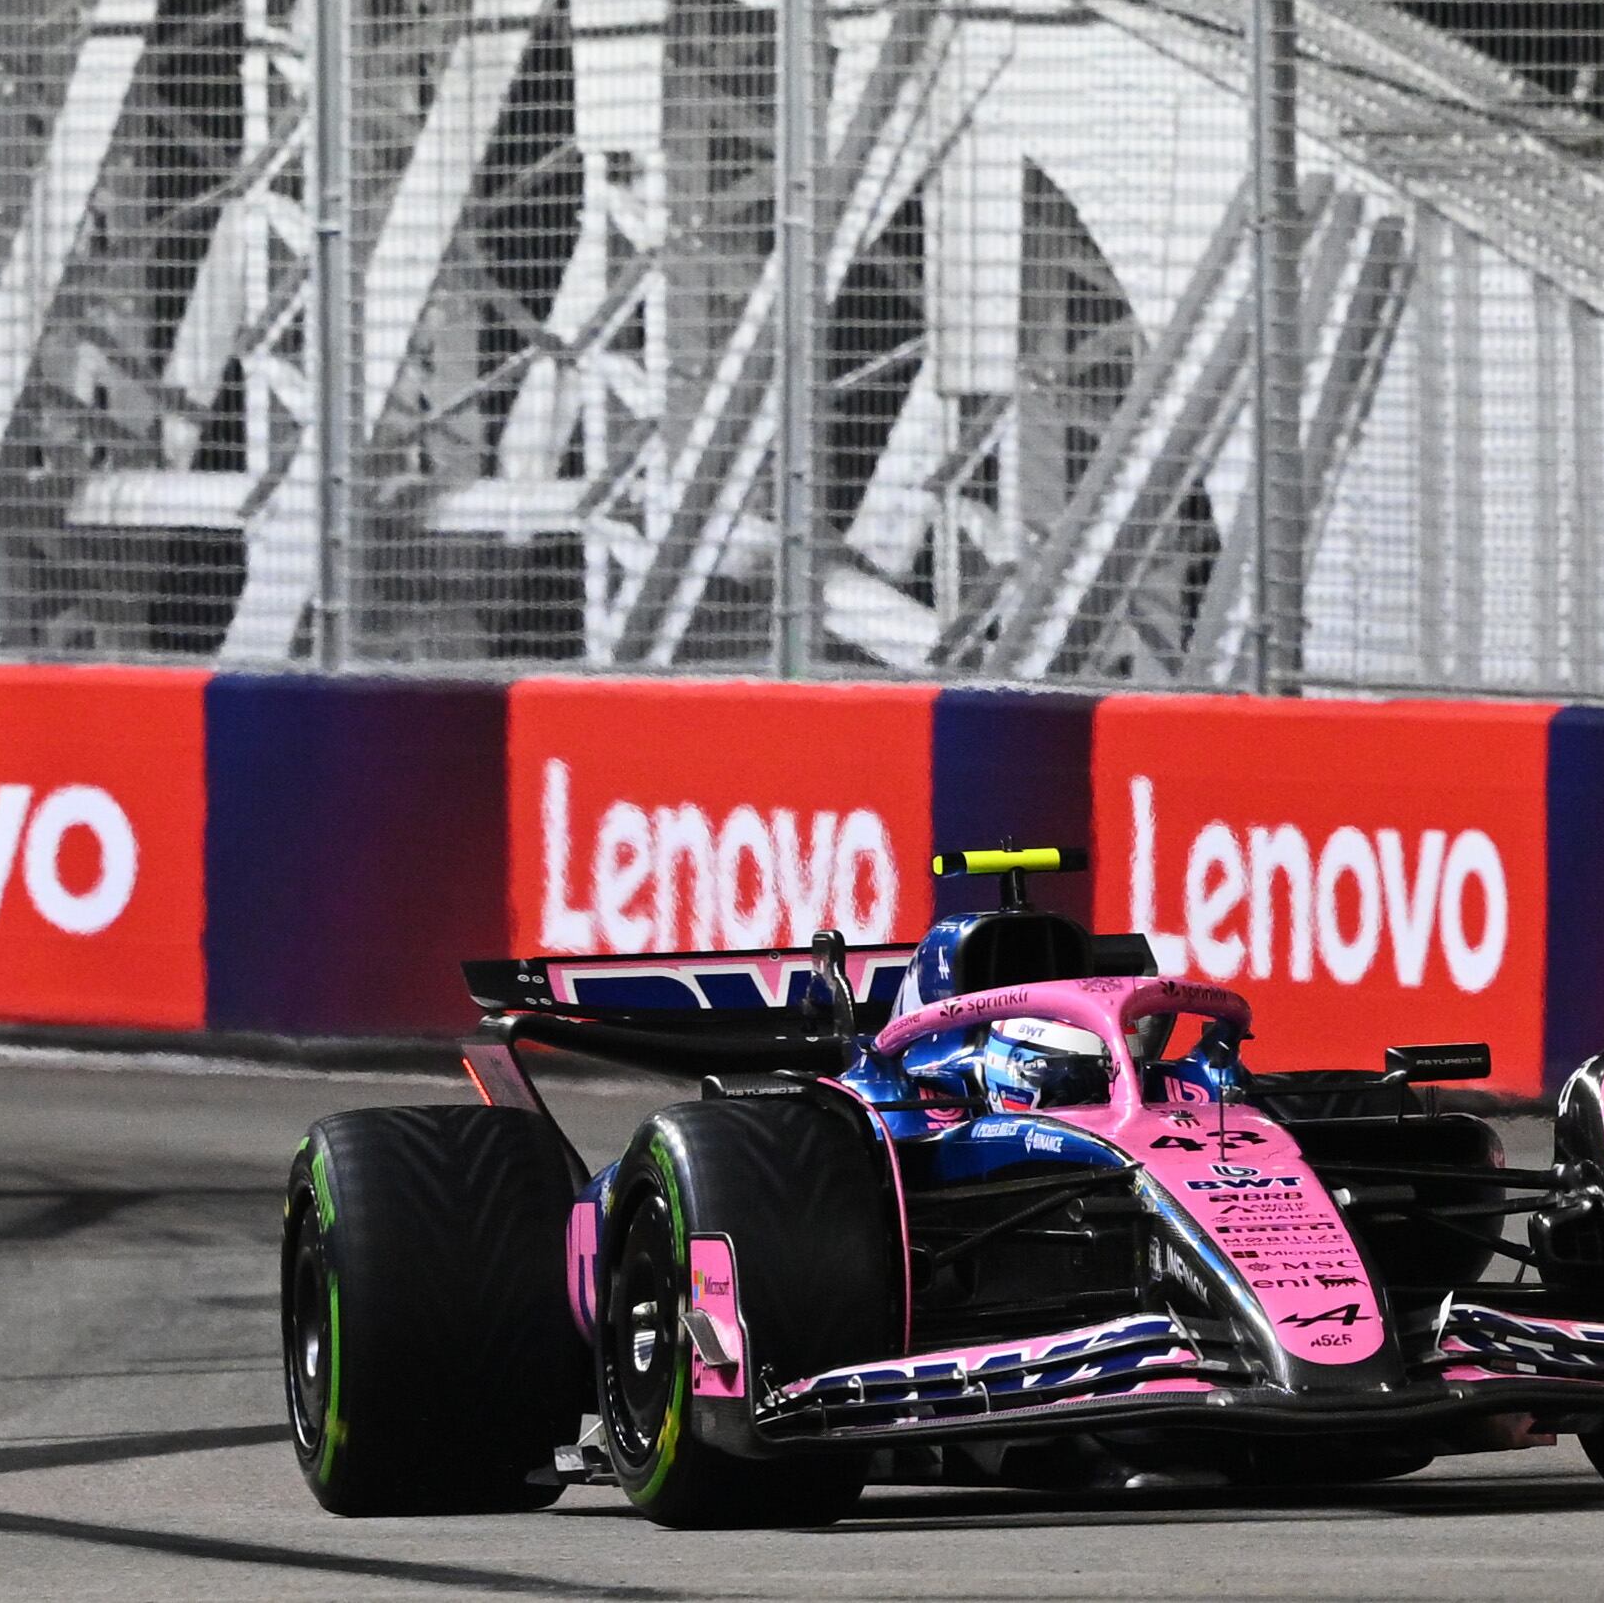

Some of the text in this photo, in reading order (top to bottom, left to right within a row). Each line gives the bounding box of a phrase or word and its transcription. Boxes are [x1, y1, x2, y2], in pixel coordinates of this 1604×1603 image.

[540, 756, 899, 954] Lenovo
[1129, 774, 1508, 995] Lenovo
[966, 987, 1029, 1016] sprinklr
[1018, 1023, 1046, 1038] BWT
[1032, 1132, 1064, 1153] BINANCE
[1149, 1129, 1268, 1152] 43
[1185, 1176, 1303, 1191] BWT
[1243, 1191, 1303, 1202] BRB
[1238, 1213, 1330, 1221] BINANCE
[1264, 1247, 1353, 1257] Microsoft
[1281, 1259, 1361, 1271] MSC
[1251, 1275, 1311, 1289] eni
